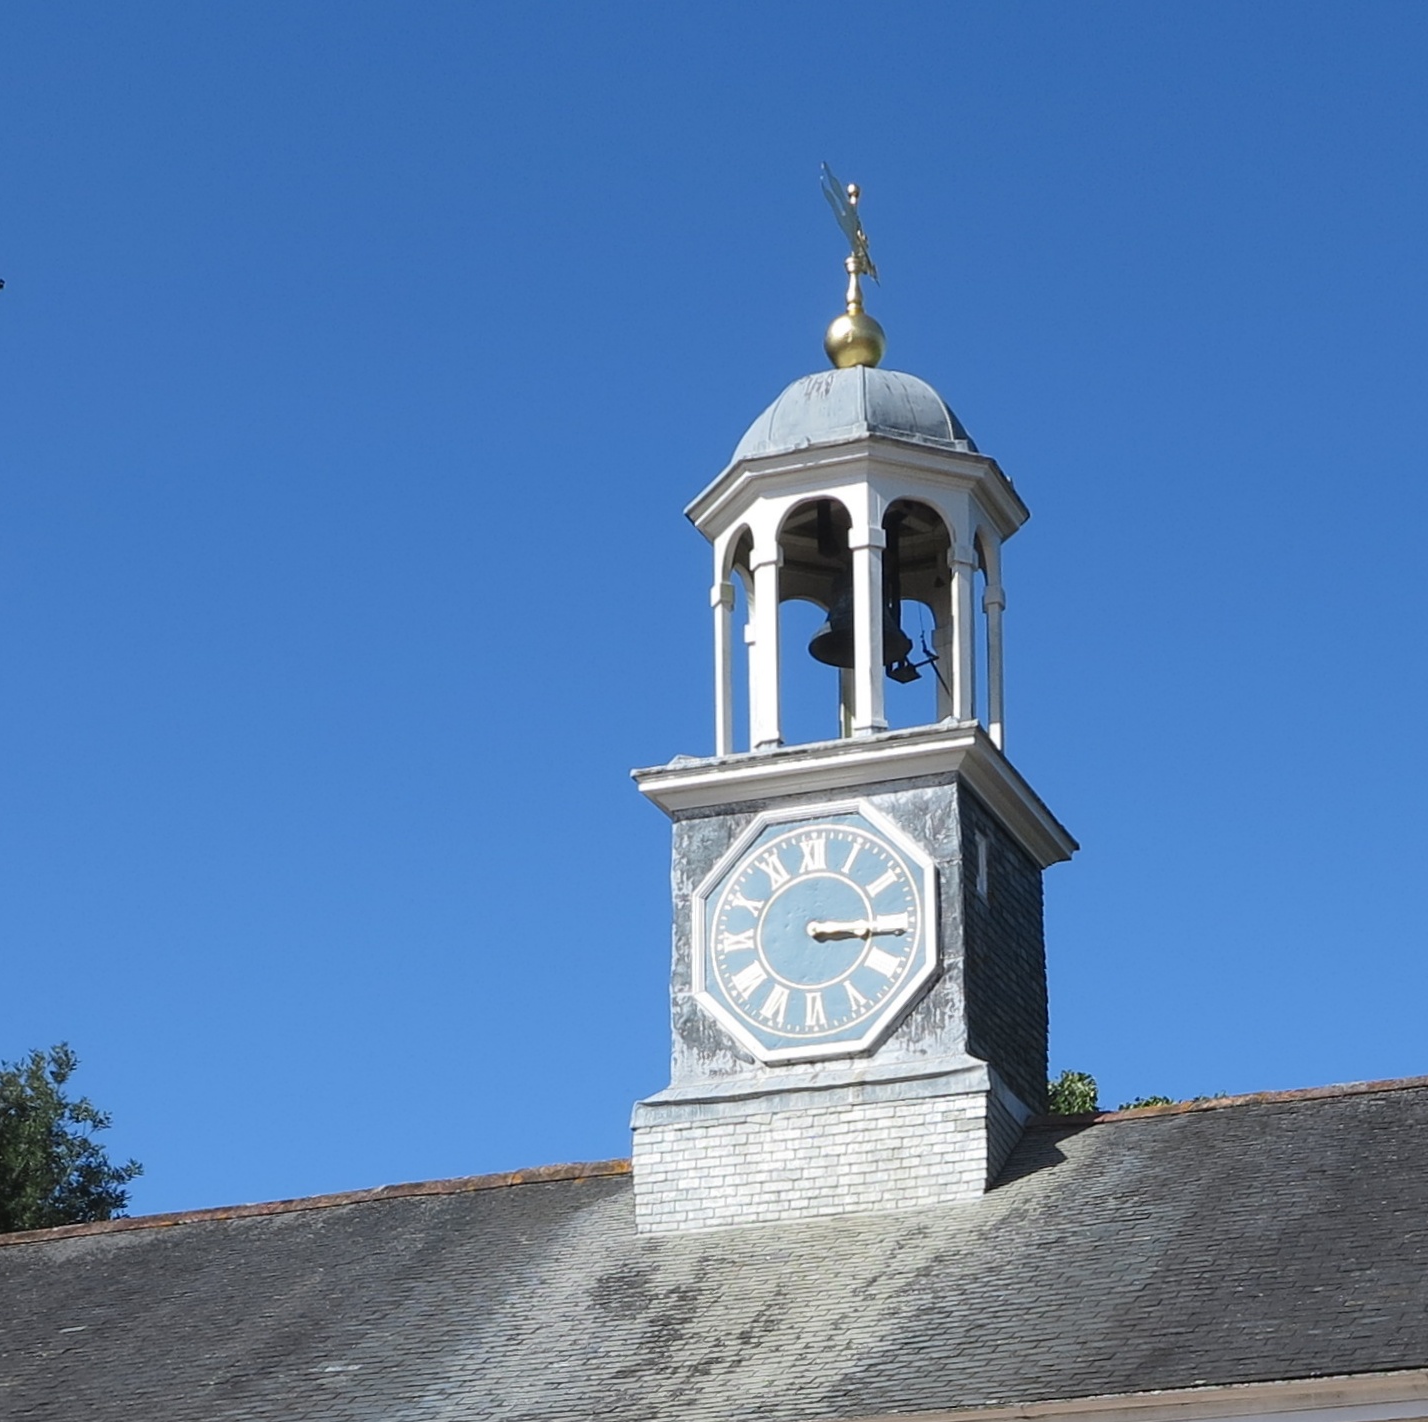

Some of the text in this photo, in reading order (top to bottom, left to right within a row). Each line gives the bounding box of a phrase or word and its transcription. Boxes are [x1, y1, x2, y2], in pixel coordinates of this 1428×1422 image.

[756, 848, 791, 891] XI
[799, 838, 827, 873] XII
[842, 843, 862, 874] I
[866, 869, 898, 897] II
[732, 893, 764, 917] X
[723, 929, 754, 953] IX
[760, 984, 791, 1024] VII
[805, 992, 826, 1026] VI
[843, 981, 868, 1009] V
